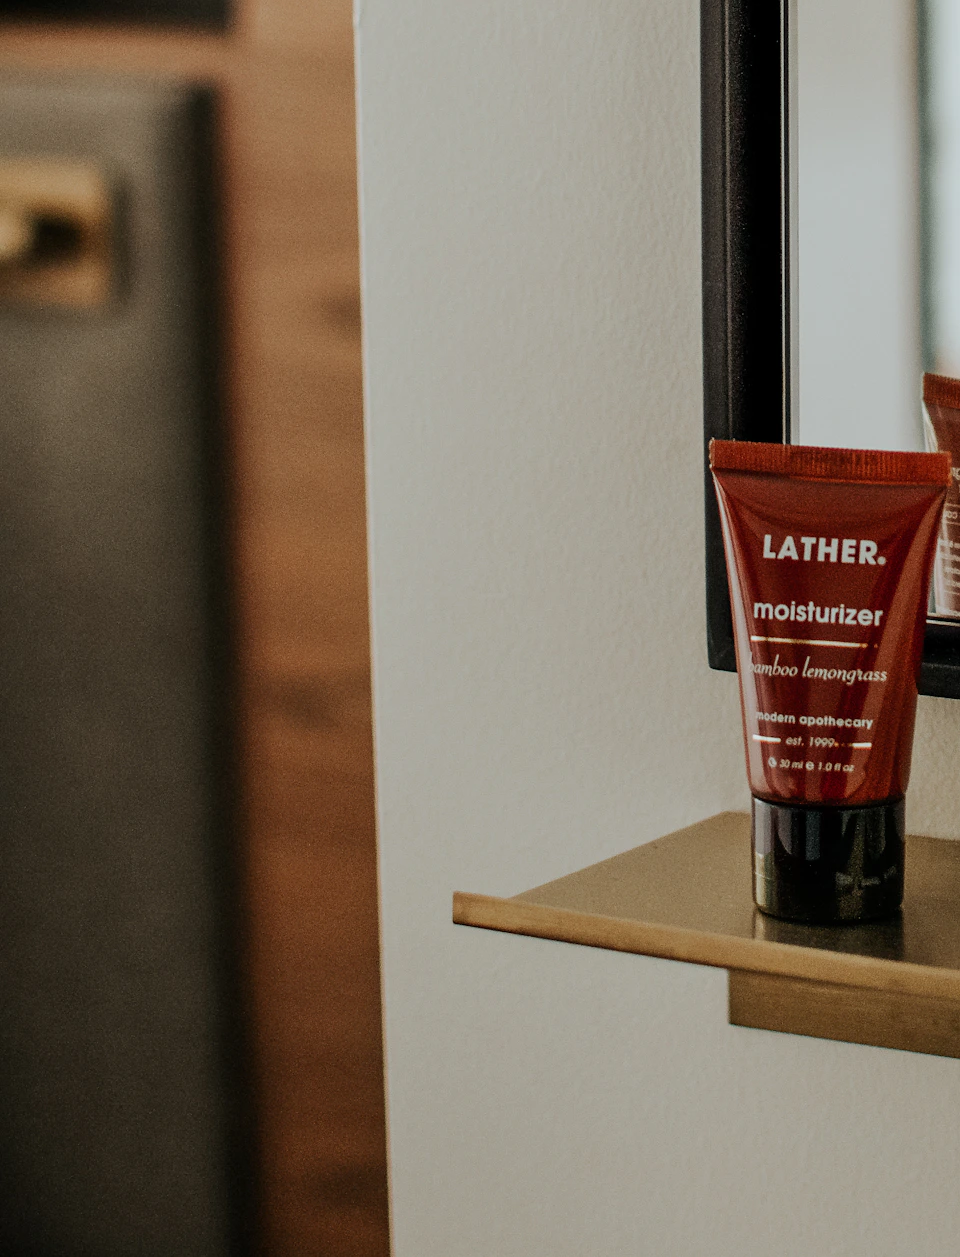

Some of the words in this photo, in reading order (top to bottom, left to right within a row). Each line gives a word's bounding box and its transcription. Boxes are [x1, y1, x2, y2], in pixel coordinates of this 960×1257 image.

[753, 600, 884, 627] moisturizer
[801, 655, 888, 686] lemongrass
[757, 710, 796, 724] modern
[799, 715, 874, 731] apothecary
[785, 736, 805, 747] est.
